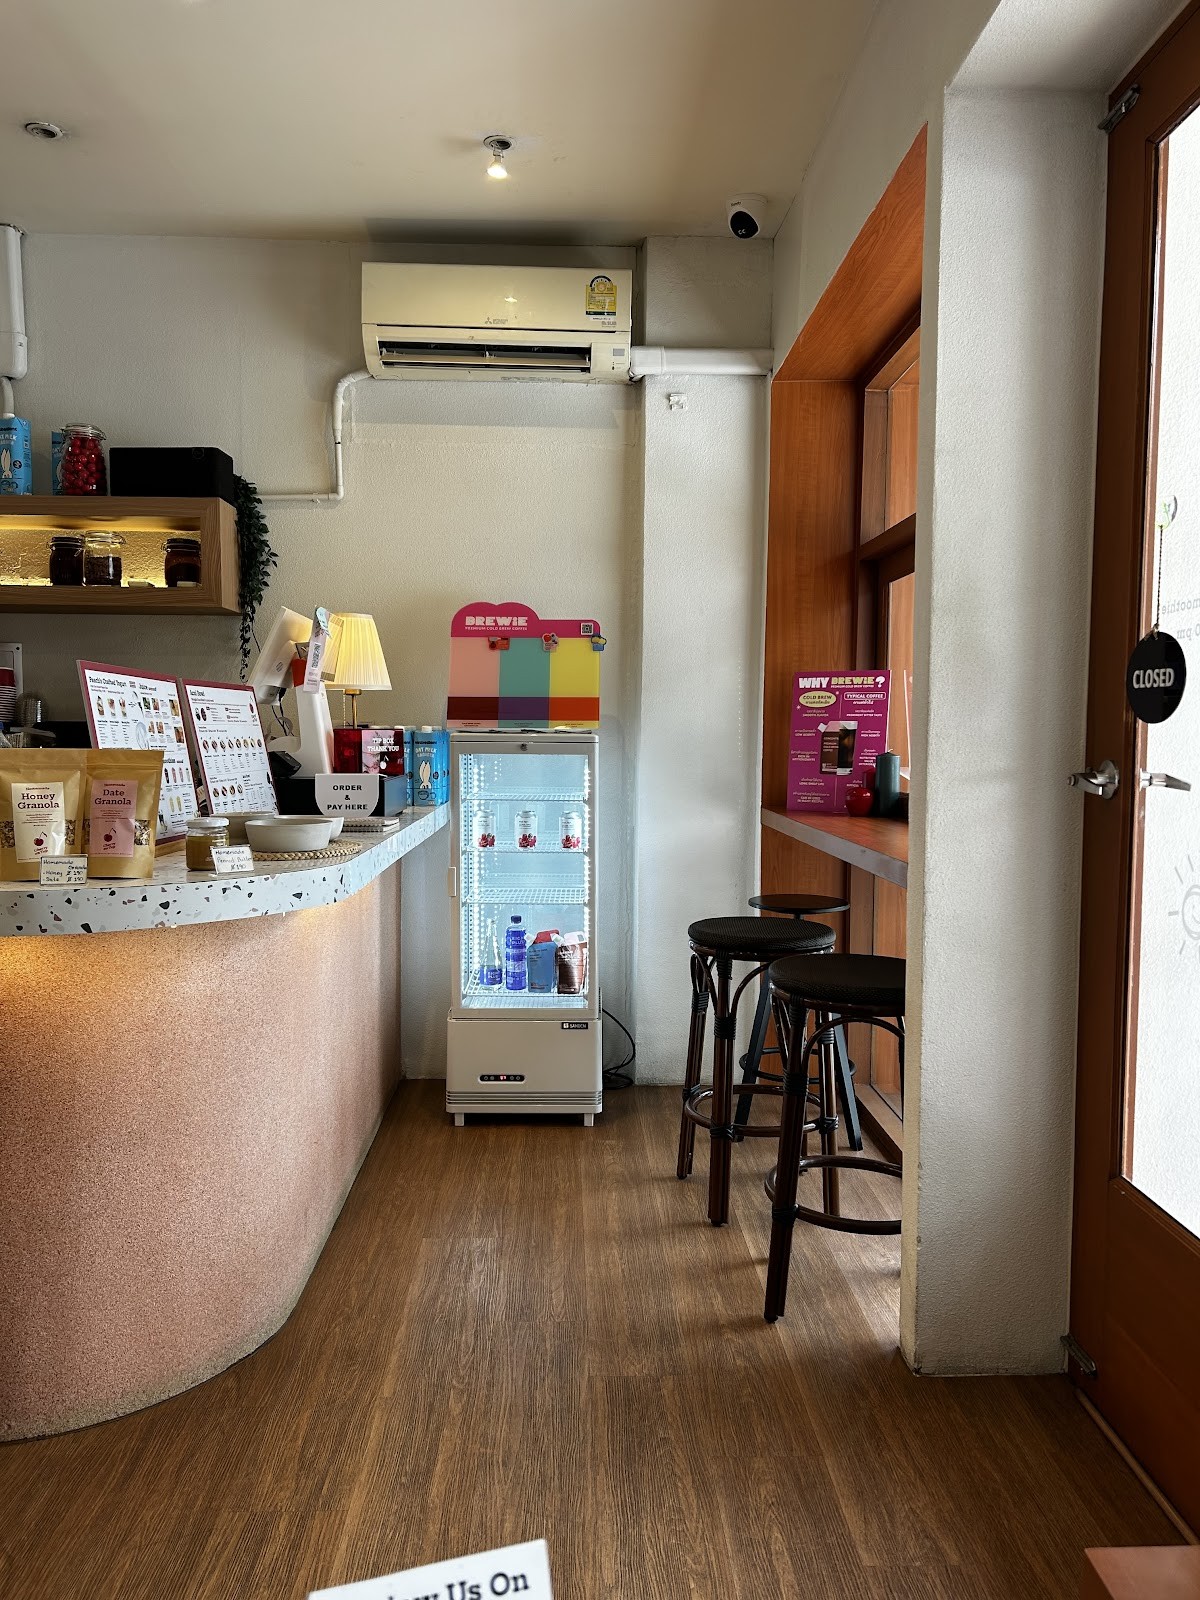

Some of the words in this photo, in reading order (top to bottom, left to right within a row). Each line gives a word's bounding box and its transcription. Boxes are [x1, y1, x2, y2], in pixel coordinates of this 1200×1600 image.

[465, 616, 528, 626] BREWIE
[798, 677, 830, 689] WHY
[1132, 667, 1175, 689] CLOSED
[21, 792, 56, 801] Honey
[17, 800, 60, 810] Granola
[94, 798, 132, 806] Granola
[446, 1580, 482, 1600] Us
[489, 1571, 530, 1596] On
